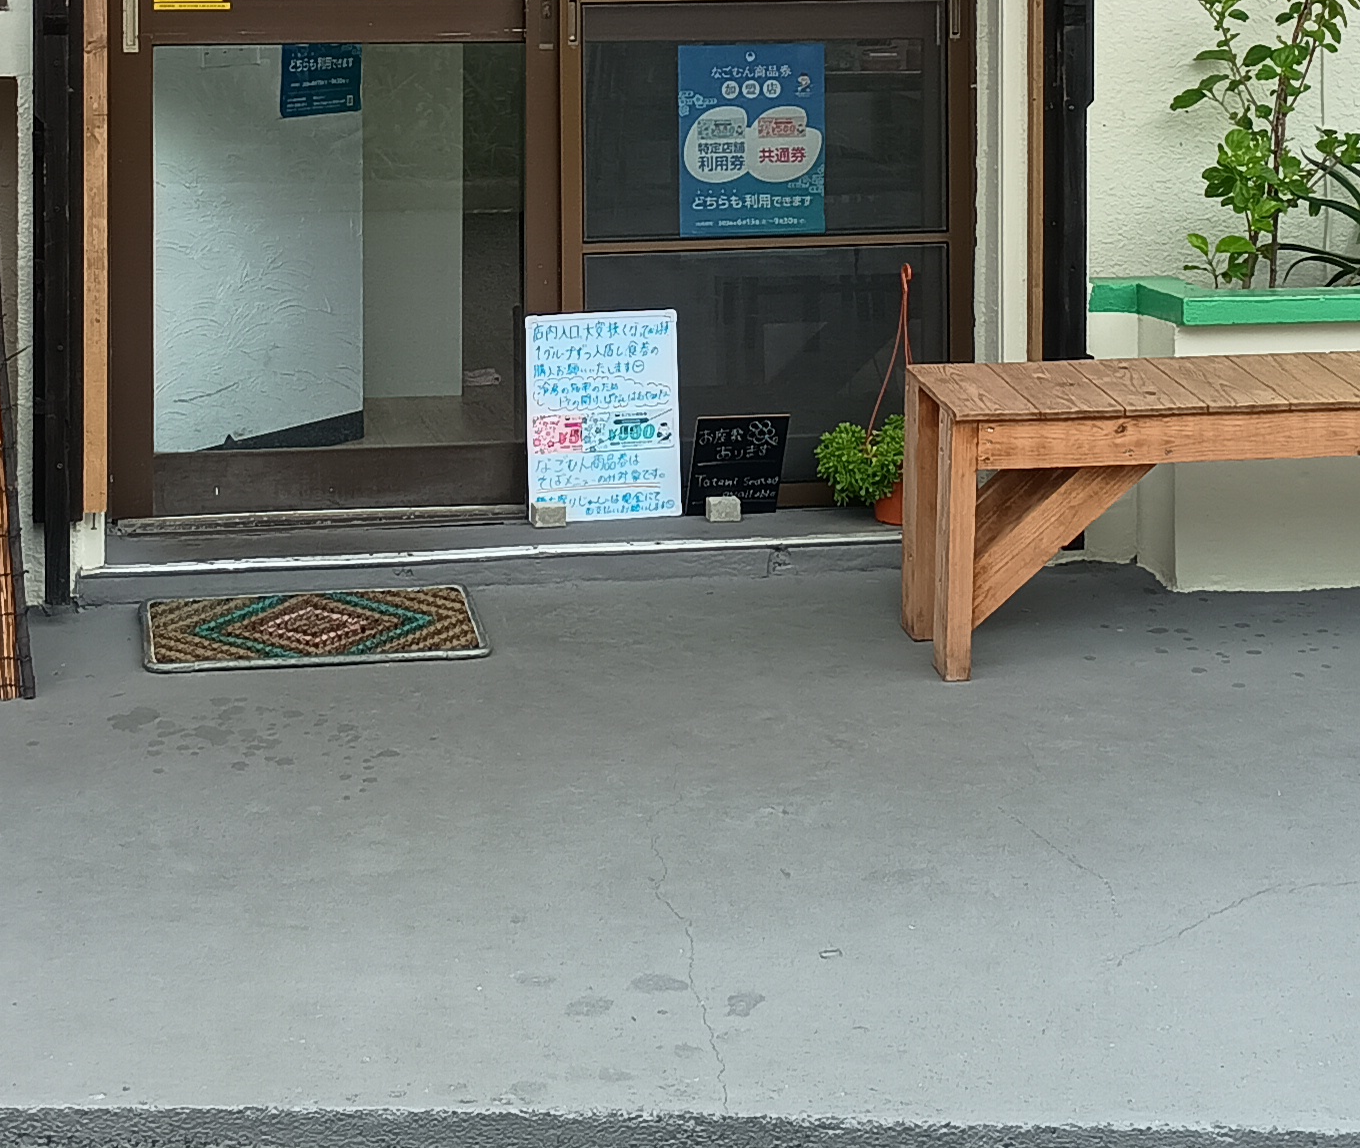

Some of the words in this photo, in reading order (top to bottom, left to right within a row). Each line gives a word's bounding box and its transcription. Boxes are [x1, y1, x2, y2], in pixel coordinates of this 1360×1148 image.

[711, 65, 792, 79] なごむん商品券
[697, 141, 746, 155] 特定店舗
[758, 147, 807, 163] 共通券
[697, 156, 746, 172] 利用券
[692, 194, 812, 210] どちらも利用できます
